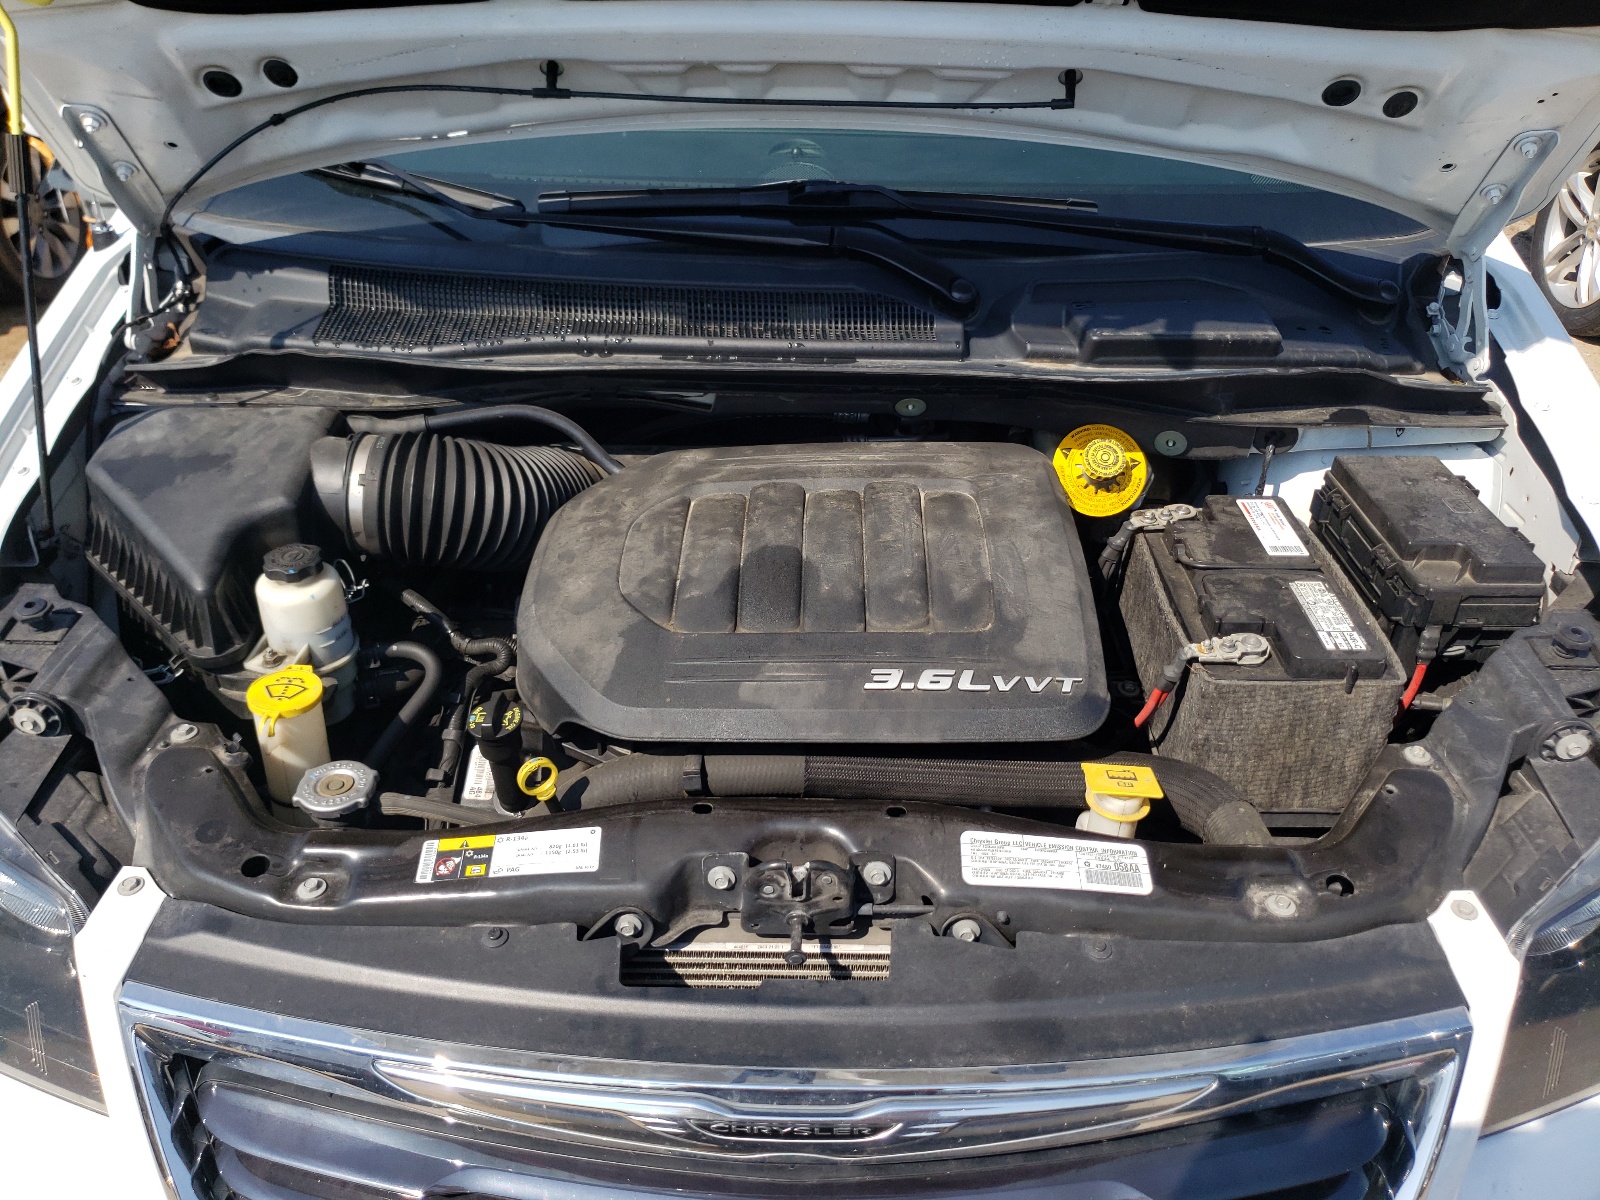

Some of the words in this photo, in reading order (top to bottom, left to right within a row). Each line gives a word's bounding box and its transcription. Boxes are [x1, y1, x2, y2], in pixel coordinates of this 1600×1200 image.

[863, 668, 991, 692] 3.6L
[992, 675, 1083, 693] VVT
[709, 1122, 872, 1136] CHRYSLER
